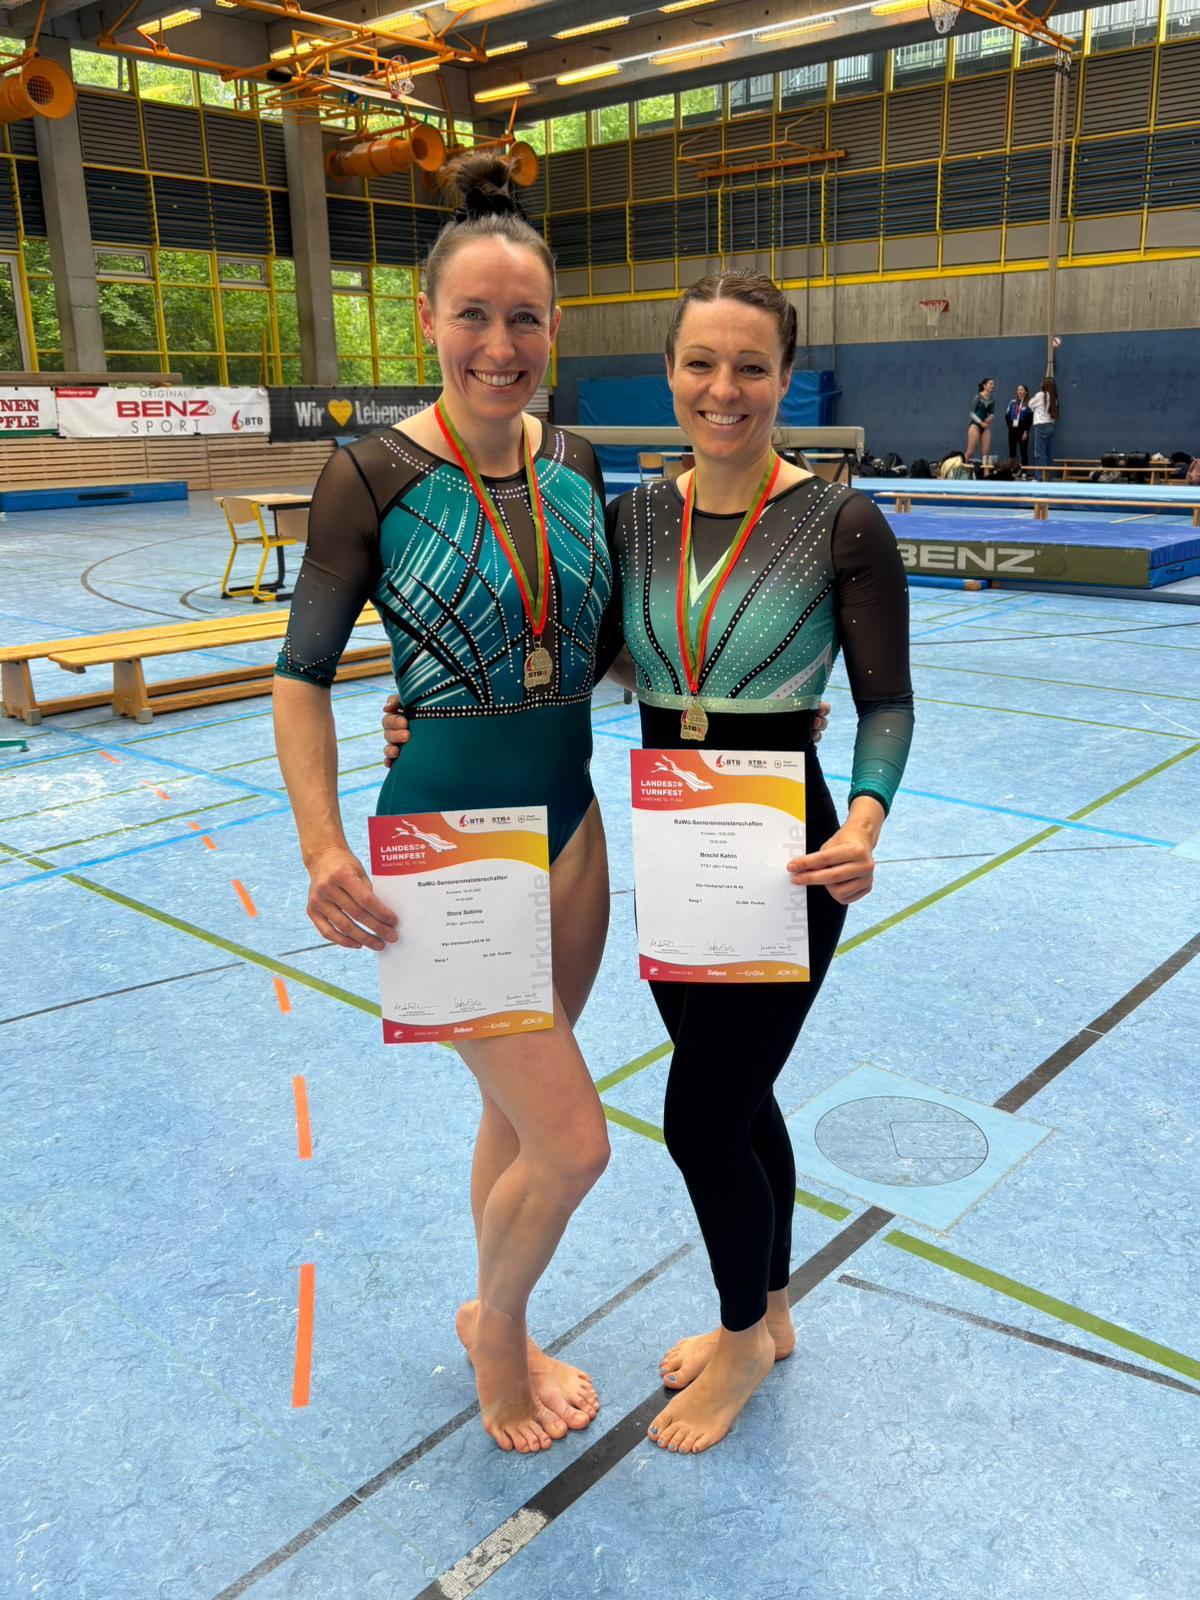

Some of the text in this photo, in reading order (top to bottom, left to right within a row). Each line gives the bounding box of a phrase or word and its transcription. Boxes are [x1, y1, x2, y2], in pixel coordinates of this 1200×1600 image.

[140, 390, 188, 398] ORIGINAL
[116, 400, 209, 417] BENZ
[294, 400, 433, 427] Wir Lebensm
[244, 417, 263, 426] BTB
[131, 419, 200, 434] SPORT
[640, 788, 683, 796] TURNFEST
[380, 844, 415, 853] LANDES
[381, 852, 426, 861] TURNFEST
[528, 874, 552, 990] Urkunde
